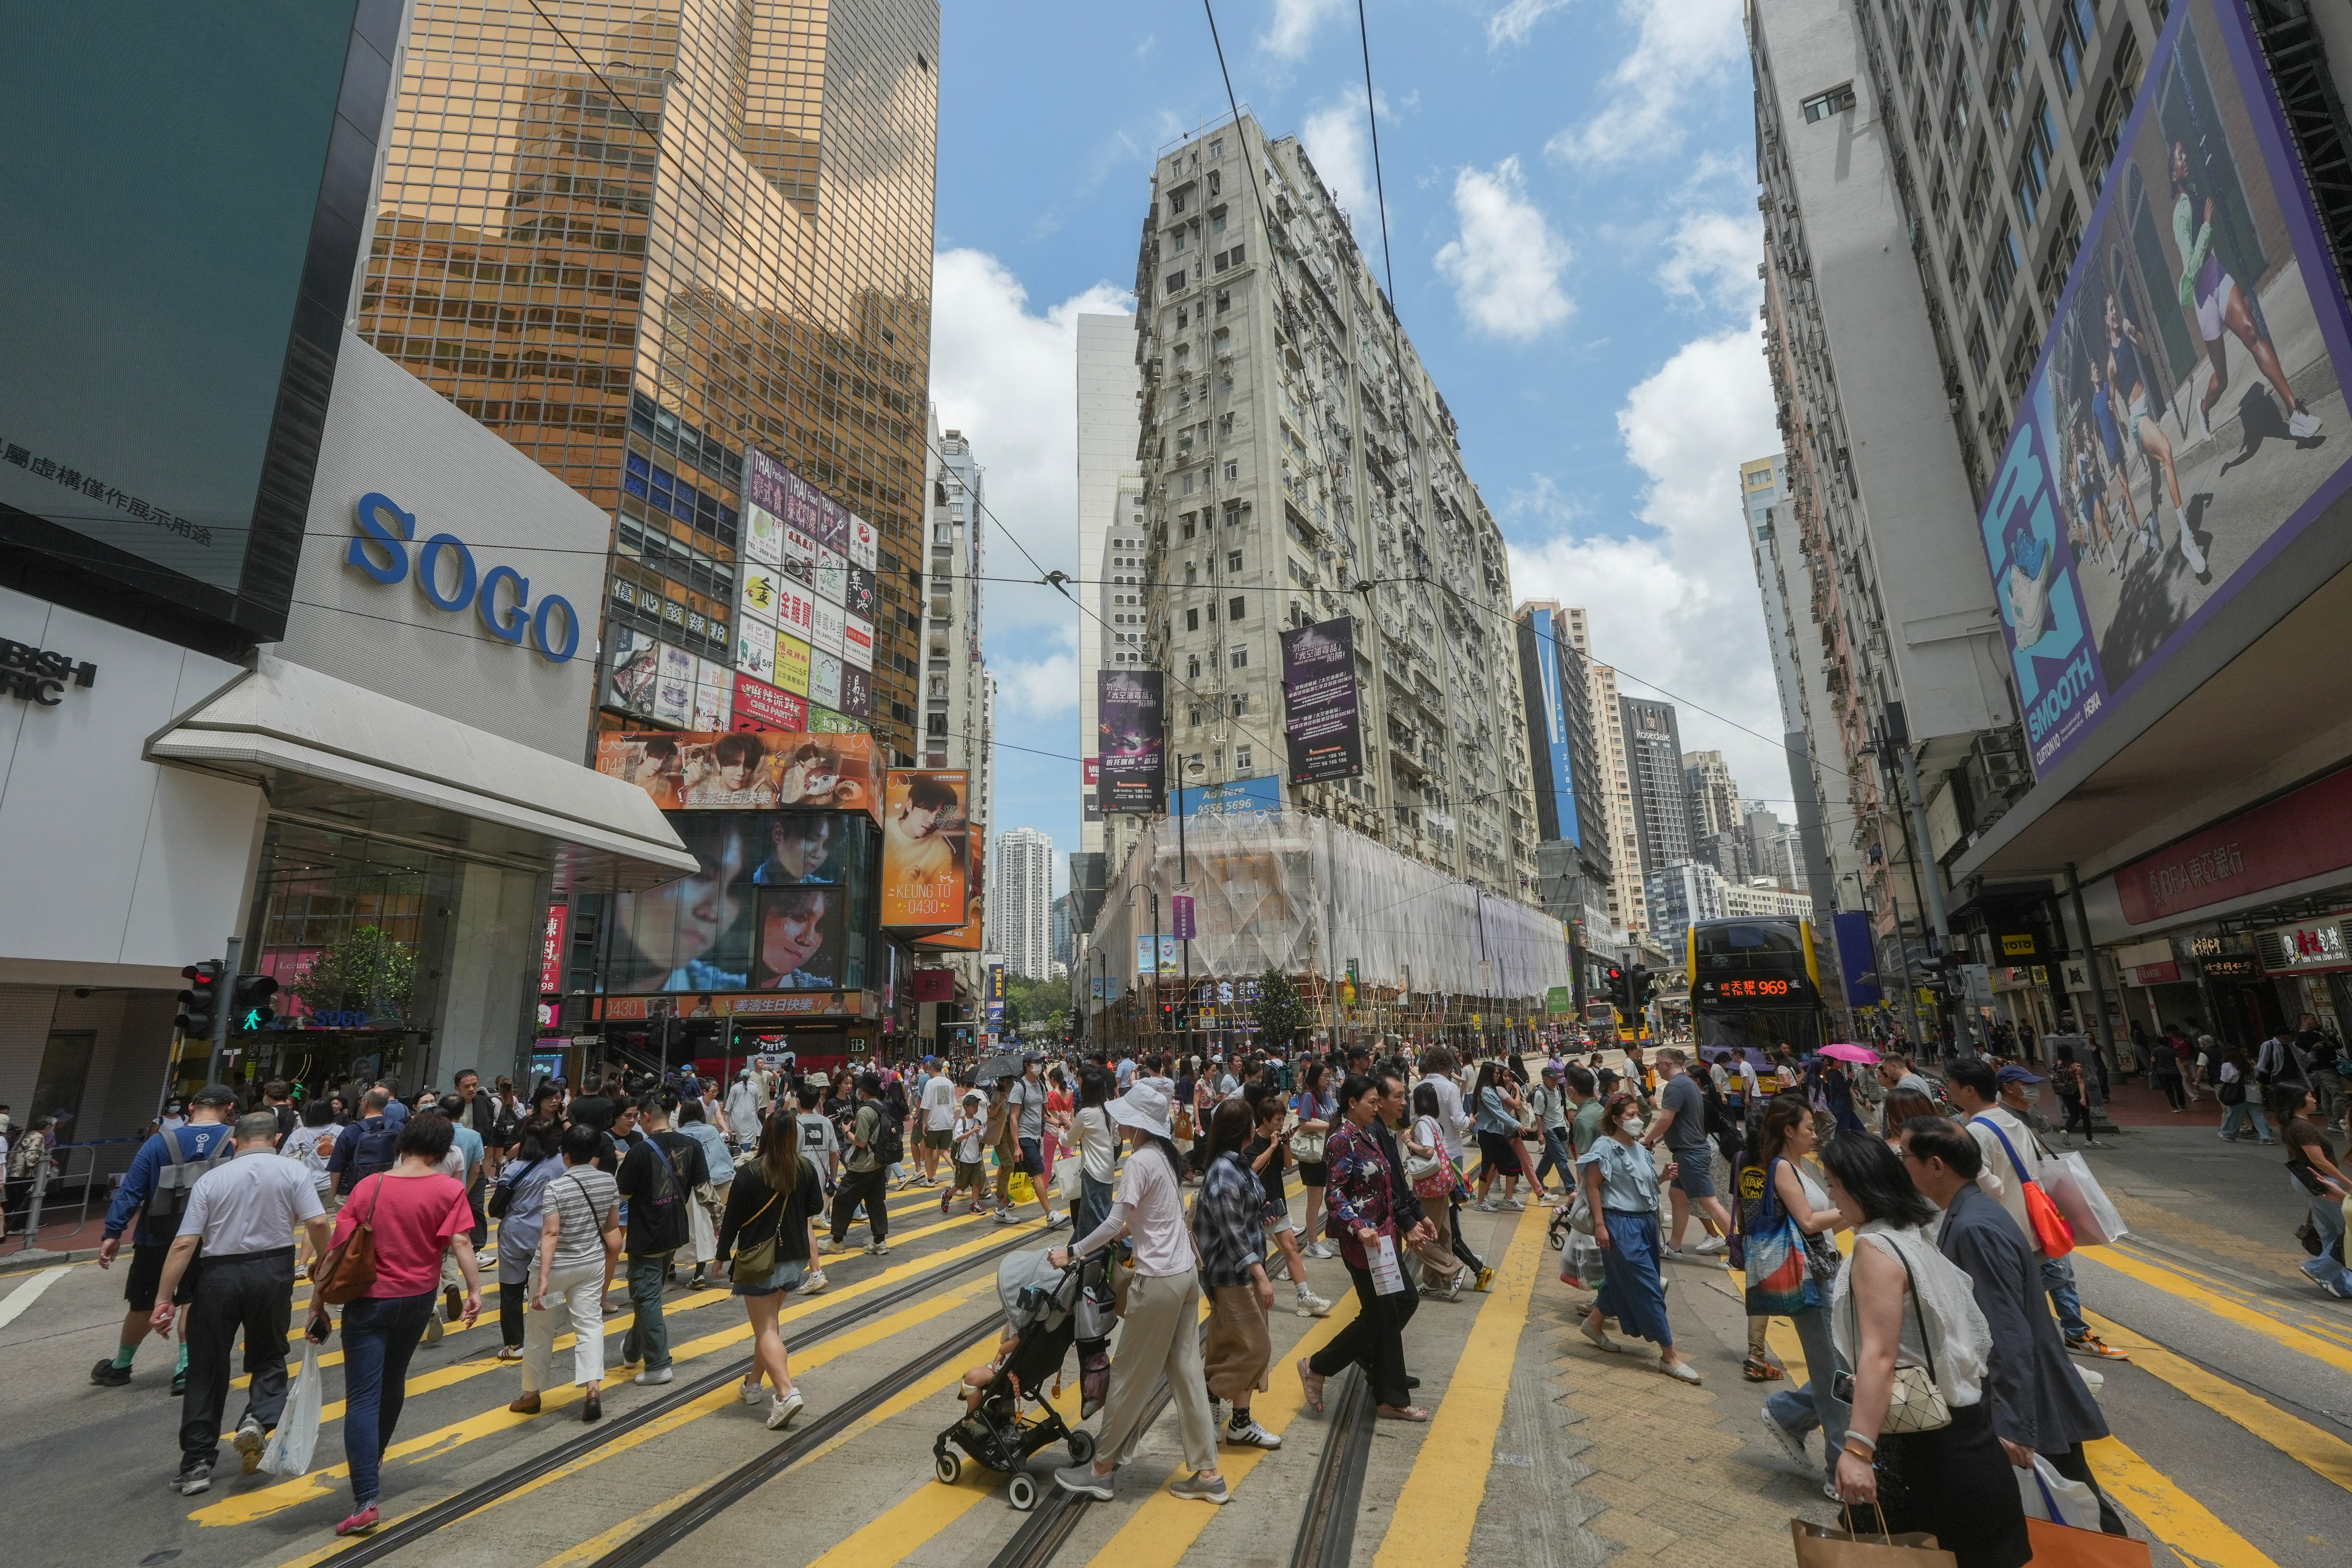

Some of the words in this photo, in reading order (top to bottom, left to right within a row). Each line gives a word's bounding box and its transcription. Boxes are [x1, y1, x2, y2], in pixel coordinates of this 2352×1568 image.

[755, 450, 773, 479] THAI
[772, 468, 785, 484] Perfect
[723, 478, 739, 491] PERFECT
[790, 473, 807, 501] THAI
[807, 491, 818, 505] Food
[822, 497, 834, 515] THAI
[771, 518, 782, 530] 7/F
[759, 547, 769, 557] 2668
[770, 553, 779, 562] 8483
[835, 559, 844, 569] 7/F
[348, 492, 580, 663] SOGO
[780, 591, 812, 629] 金羅寶
[747, 621, 770, 640] 新巴黎
[815, 610, 843, 638] 韓國料理
[815, 629, 832, 640] TEL:2895
[832, 638, 841, 646] 3986
[845, 644, 861, 656] TEL:2895
[1295, 643, 1341, 660] 「太空油毒品」
[762, 659, 773, 669] 5/F
[777, 671, 805, 686] 正宗重慶風味
[799, 668, 807, 677] 5/F
[751, 685, 794, 712] 麻辣派對
[2029, 647, 2095, 743] SMOOTH
[750, 700, 769, 712] CHILI
[770, 705, 793, 721] PARTY
[2084, 691, 2102, 720] HOKA
[1636, 729, 1670, 741] Rosedale
[2037, 737, 2055, 766] CLIFTON
[2053, 733, 2061, 750] 10
[600, 758, 635, 774] 0430
[688, 791, 772, 805] 姜濤生日快樂
[1203, 790, 1217, 800] Ad
[1220, 787, 1245, 797] Here
[1198, 803, 1222, 814] 9556
[1226, 798, 1252, 810] 5696
[2161, 863, 2194, 897] BEA
[2189, 843, 2245, 887] 東亞銀行
[897, 884, 933, 898] KEUNG
[937, 883, 951, 898] TO
[908, 900, 938, 914] 0430
[2191, 937, 2221, 957] 北京同仁堂
[2204, 961, 2252, 971] 北京同仁堂
[1759, 980, 1787, 995] 969
[605, 1001, 637, 1017] 0430
[736, 999, 813, 1013] 姜濤生日快樂
[315, 1009, 367, 1026] SOGO
[760, 1040, 787, 1052] THIS
[850, 1038, 865, 1052] iB
